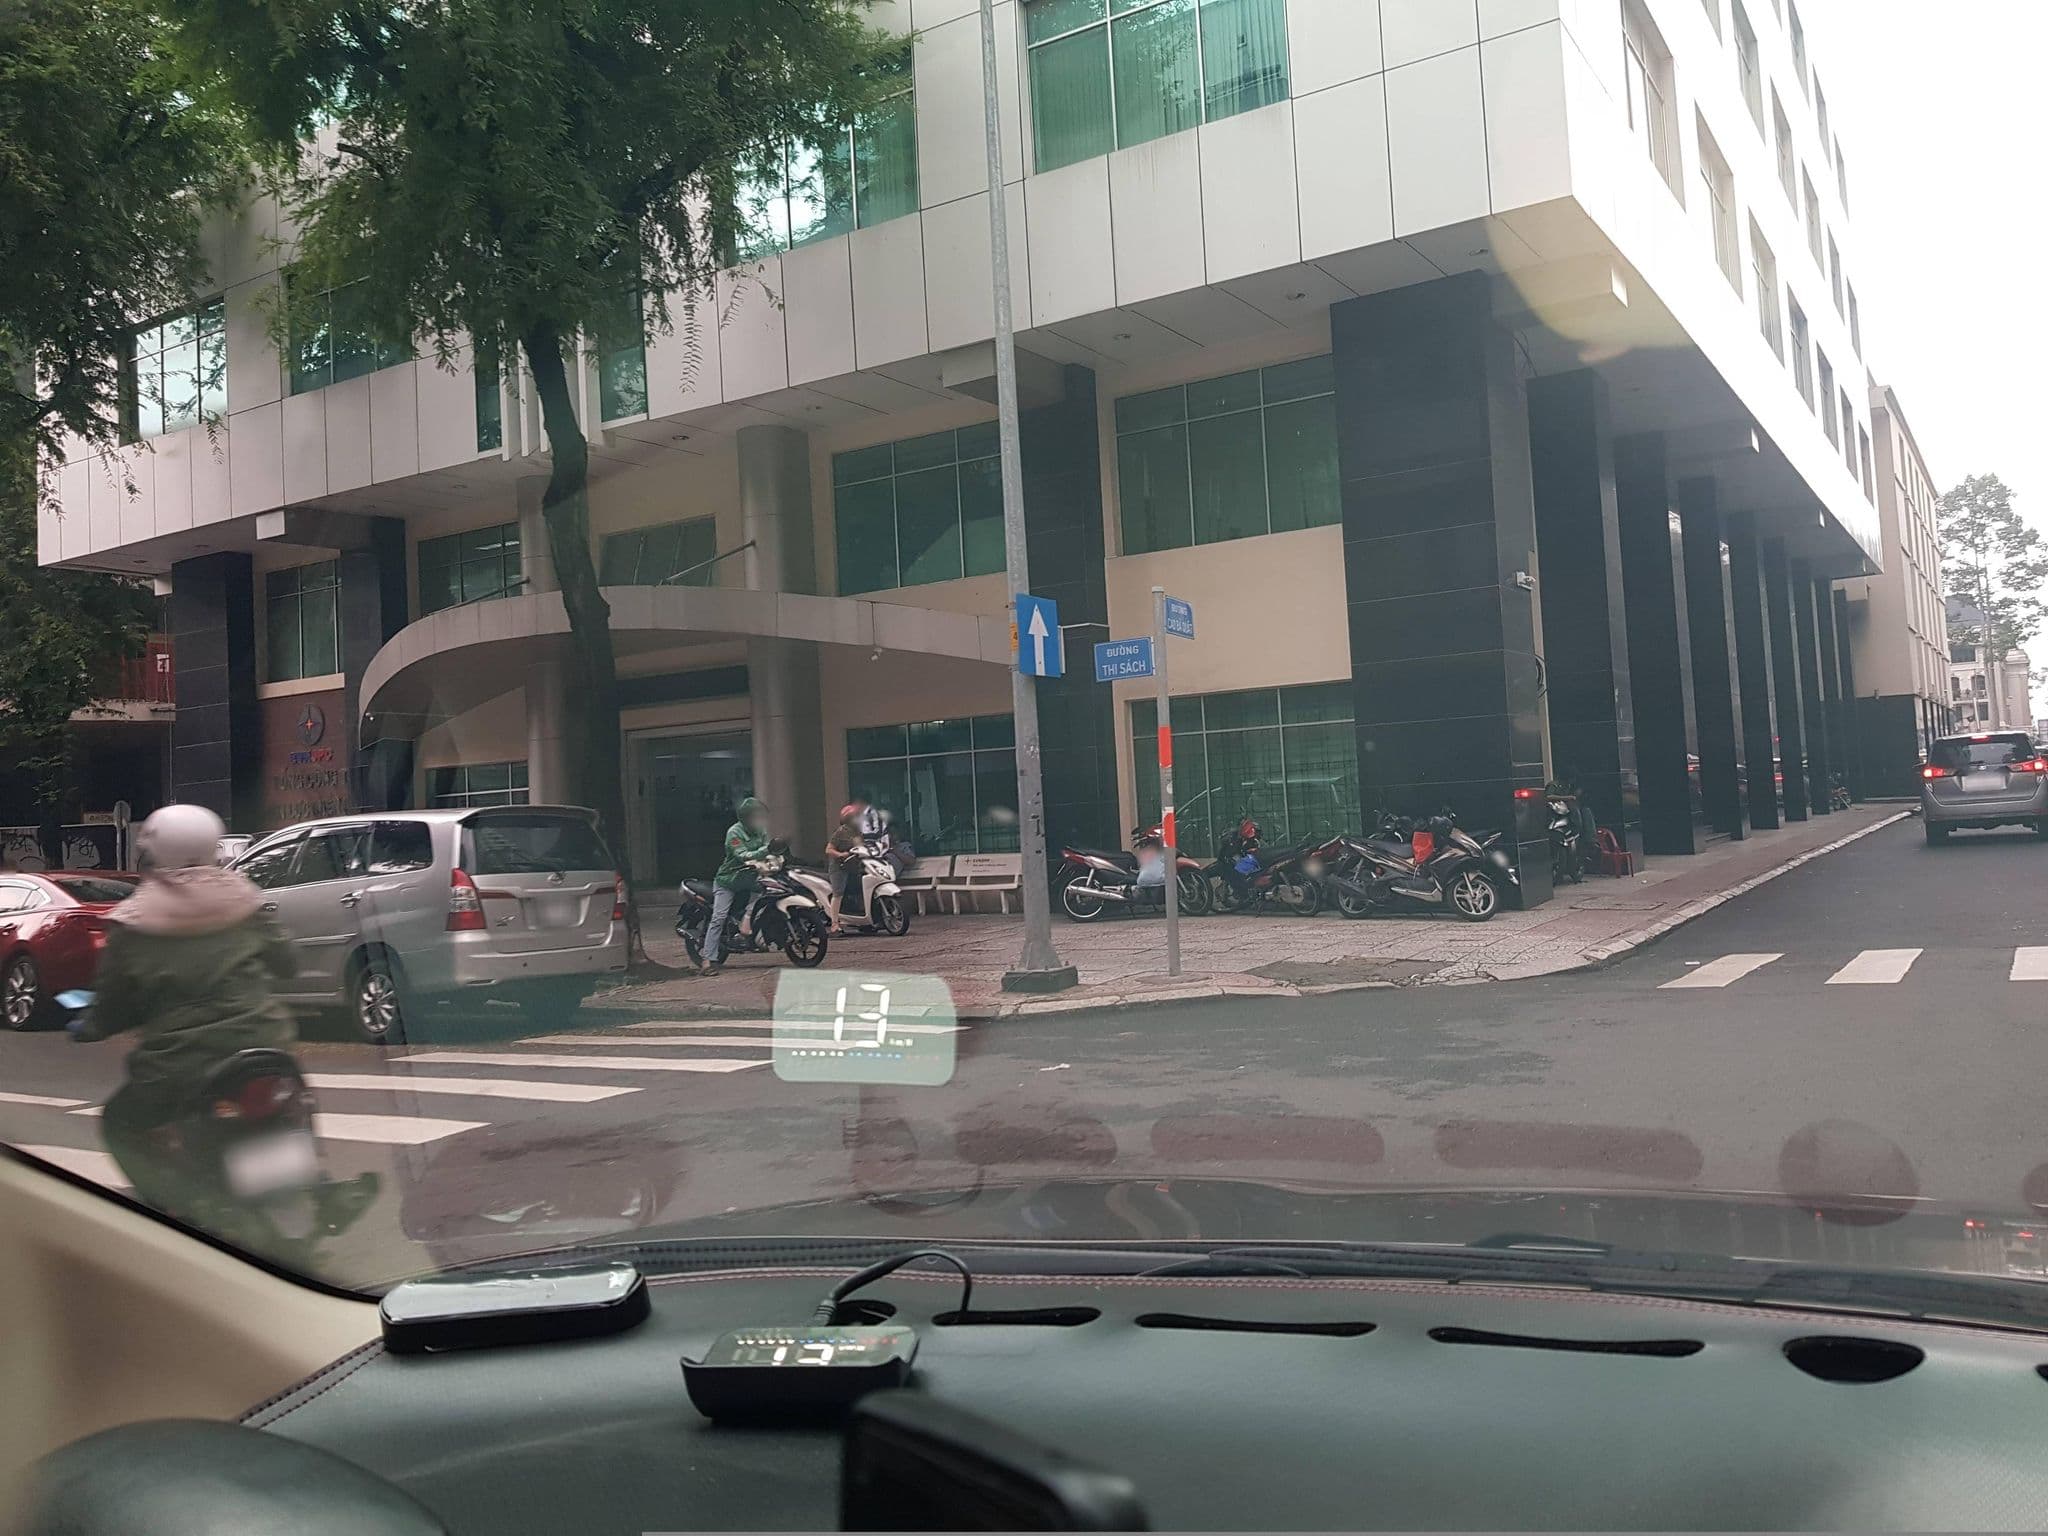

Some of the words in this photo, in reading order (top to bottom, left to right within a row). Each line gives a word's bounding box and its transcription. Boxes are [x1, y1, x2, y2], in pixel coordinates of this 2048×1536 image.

[1106, 645, 1139, 658] ĐƯỜNG
[1102, 664, 1118, 676] THI
[1119, 659, 1146, 674] SÁCH
[833, 983, 891, 1048] 13
